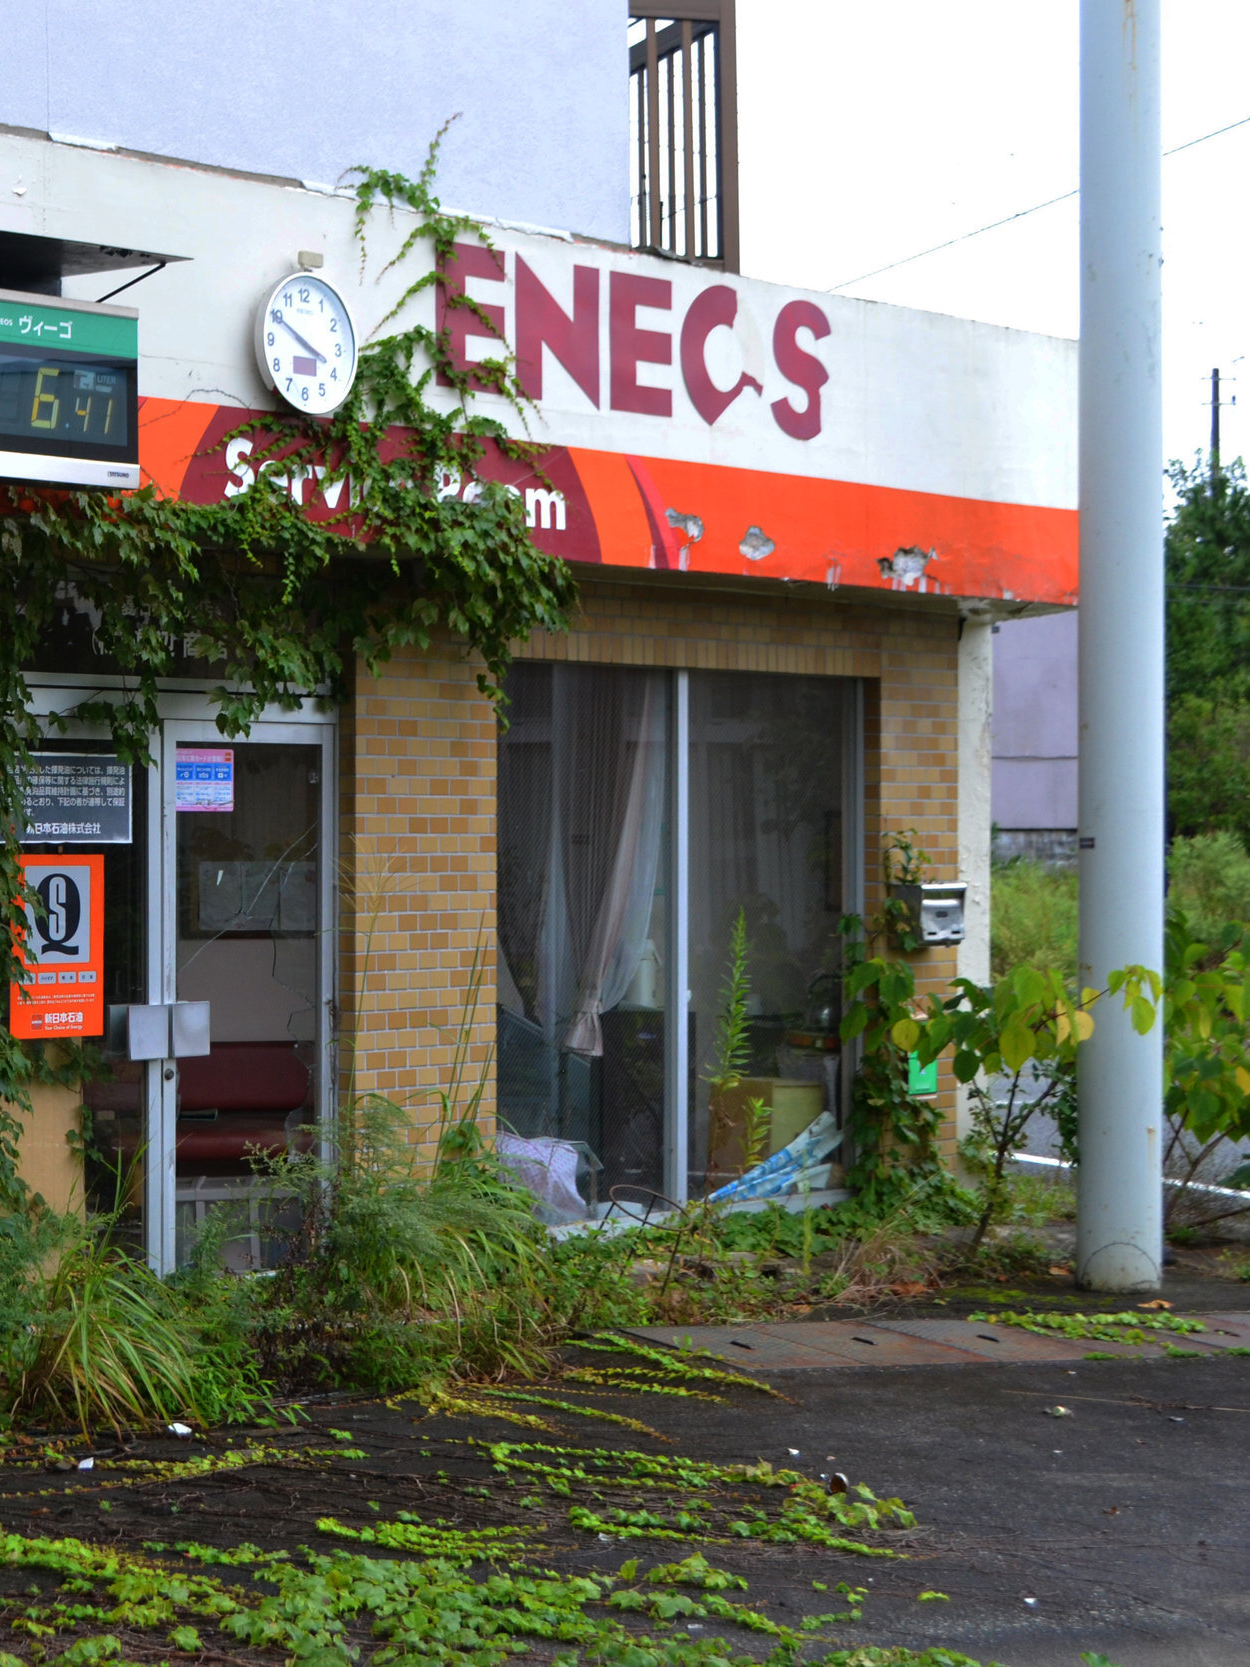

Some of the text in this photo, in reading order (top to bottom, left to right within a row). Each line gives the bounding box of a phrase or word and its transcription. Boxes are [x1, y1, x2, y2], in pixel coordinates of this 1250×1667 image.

[283, 293, 292, 307] 11
[298, 288, 310, 303] 12
[319, 299, 323, 312] 1
[270, 308, 283, 324] 10
[19, 315, 72, 339] ヴィーゴ
[330, 318, 337, 332] 2
[267, 332, 275, 346] 9
[335, 343, 342, 357] 3
[273, 358, 280, 372] 8
[330, 367, 337, 381] 4
[286, 377, 293, 392] 7
[318, 383, 326, 397] 5
[301, 387, 309, 401] 6
[224, 437, 413, 510] Serv
